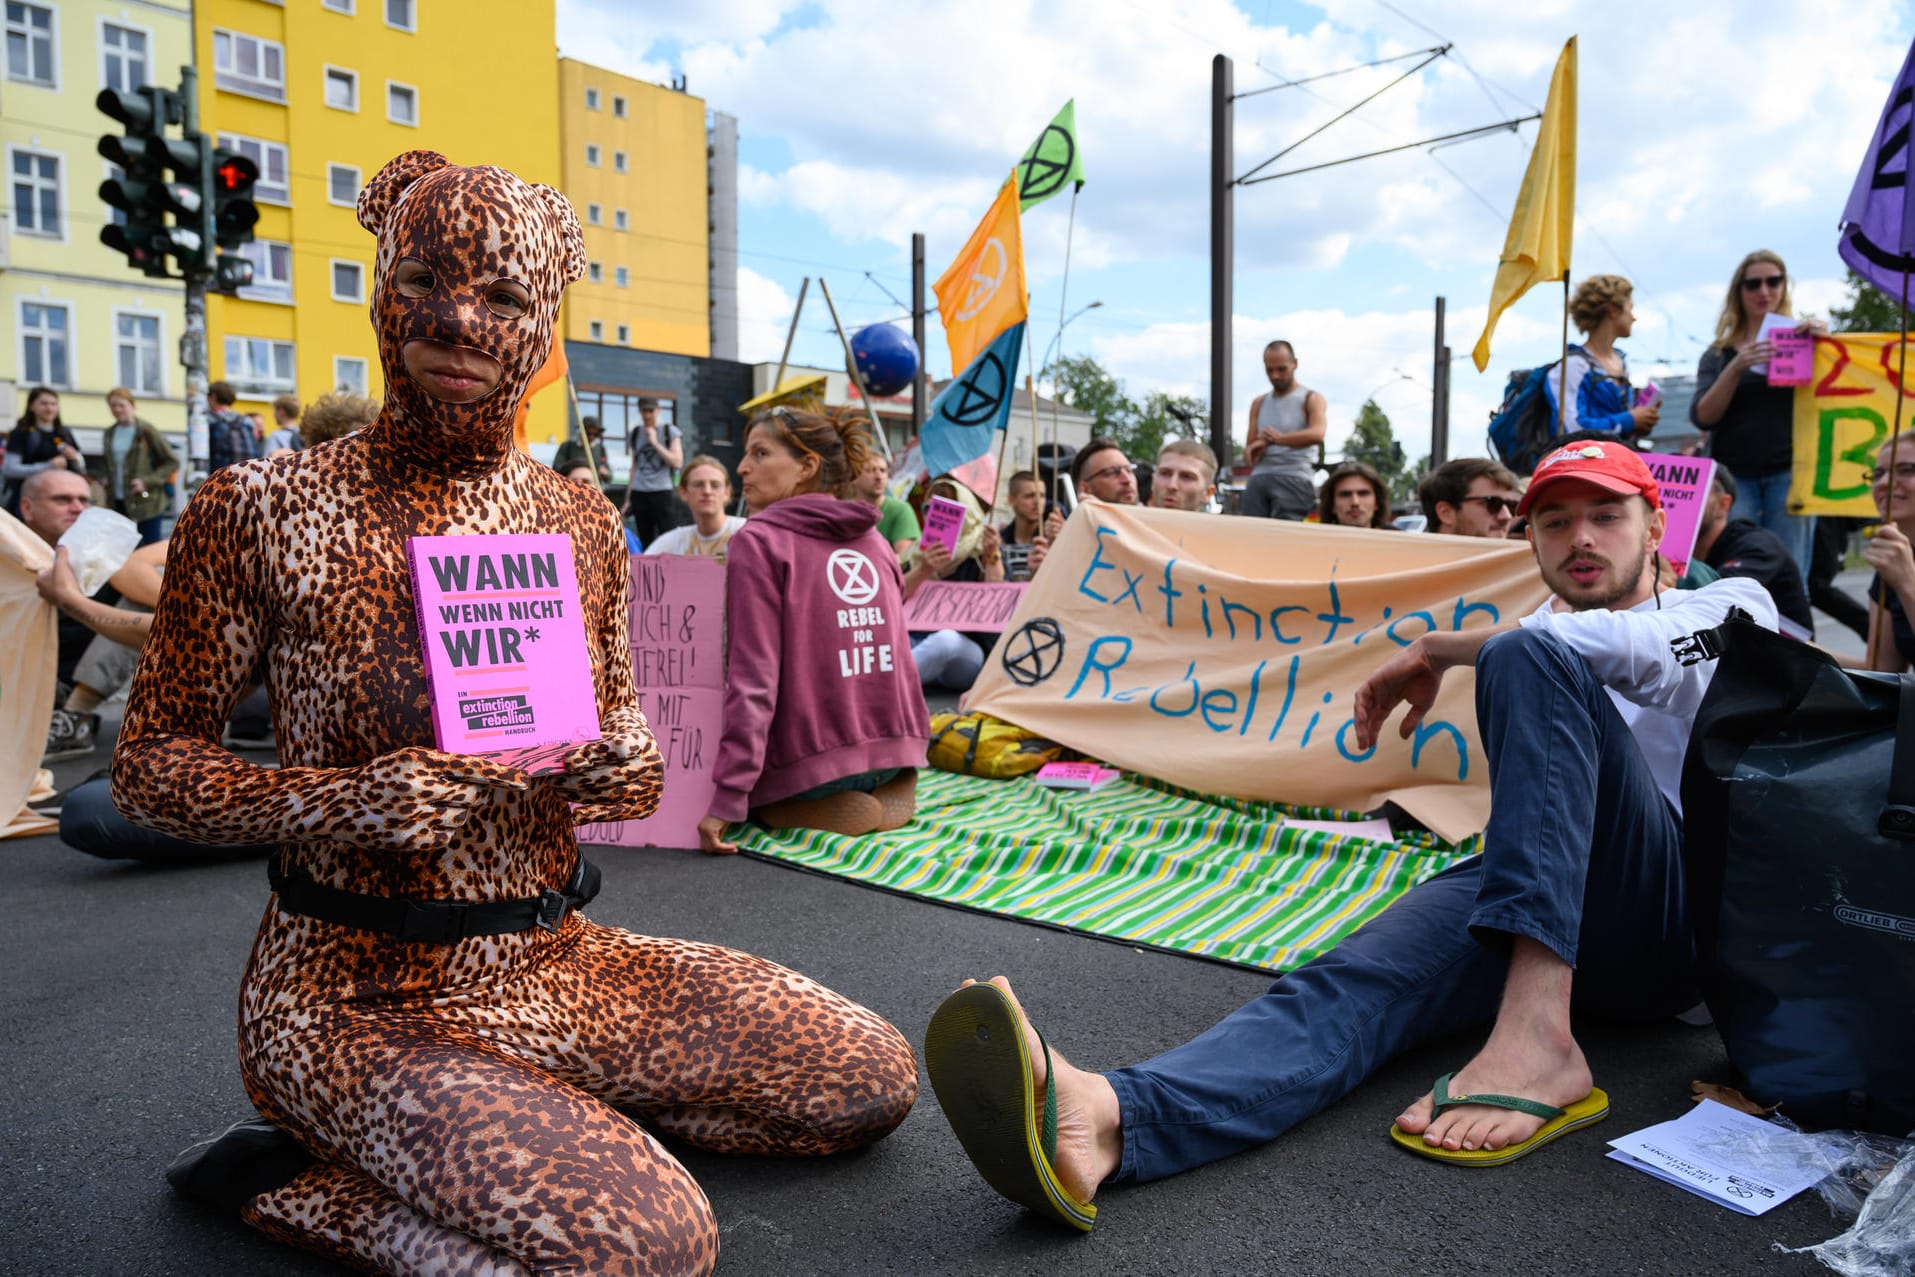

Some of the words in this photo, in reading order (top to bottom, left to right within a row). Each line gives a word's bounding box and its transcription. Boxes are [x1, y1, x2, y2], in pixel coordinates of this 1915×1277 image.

[1663, 488, 1695, 501] NICHT
[428, 553, 560, 592] WANN
[1078, 526, 1501, 648] Extinction
[438, 602, 504, 625] WENN
[508, 600, 564, 621] NICHT
[629, 604, 671, 643] LICH
[679, 604, 696, 644] &
[836, 607, 886, 629] REBEL
[853, 629, 873, 643] FOR
[631, 646, 695, 687] TFREI!
[838, 644, 894, 678] LIFE
[462, 697, 519, 714] extinction
[657, 694, 691, 726] MIT
[481, 710, 533, 728] rebellion
[504, 727, 536, 736] HANDBUCH
[667, 725, 703, 770] FÜR
[1839, 909, 1891, 927] ORTLIEB
[1640, 1142, 1696, 1170] AKTIONEN
